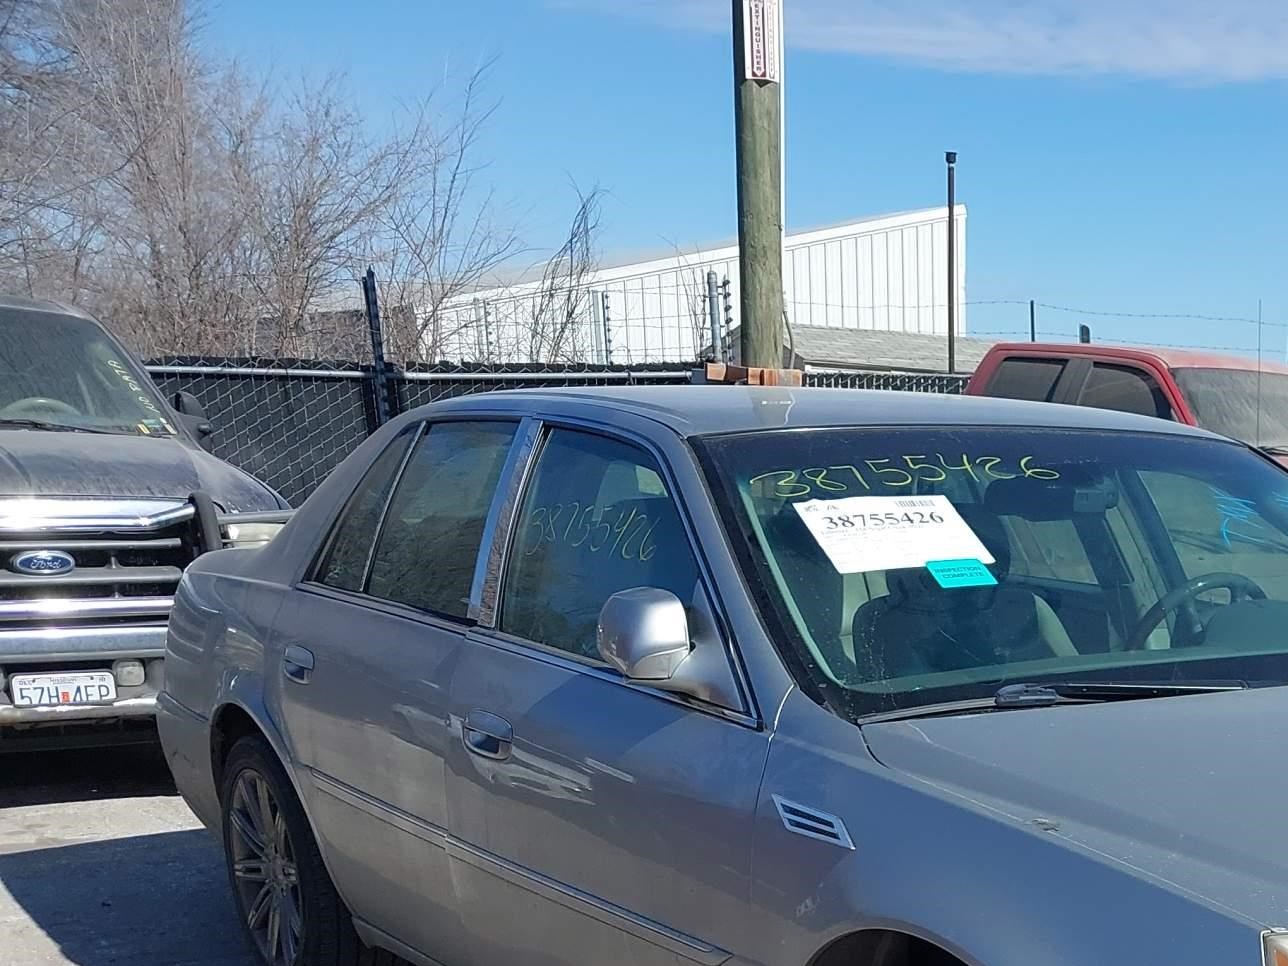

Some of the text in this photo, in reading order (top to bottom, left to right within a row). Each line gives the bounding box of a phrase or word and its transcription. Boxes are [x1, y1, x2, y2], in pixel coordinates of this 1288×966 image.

[754, 4, 762, 71] EXTINGUISHER
[750, 454, 1060, 496] 38755426
[821, 511, 944, 530] 38755426
[525, 502, 661, 561] 38755426
[30, 559, 62, 569] Ford
[933, 566, 983, 574] INSPECTION
[942, 571, 986, 579] COMPLETE
[19, 685, 60, 705] 57H
